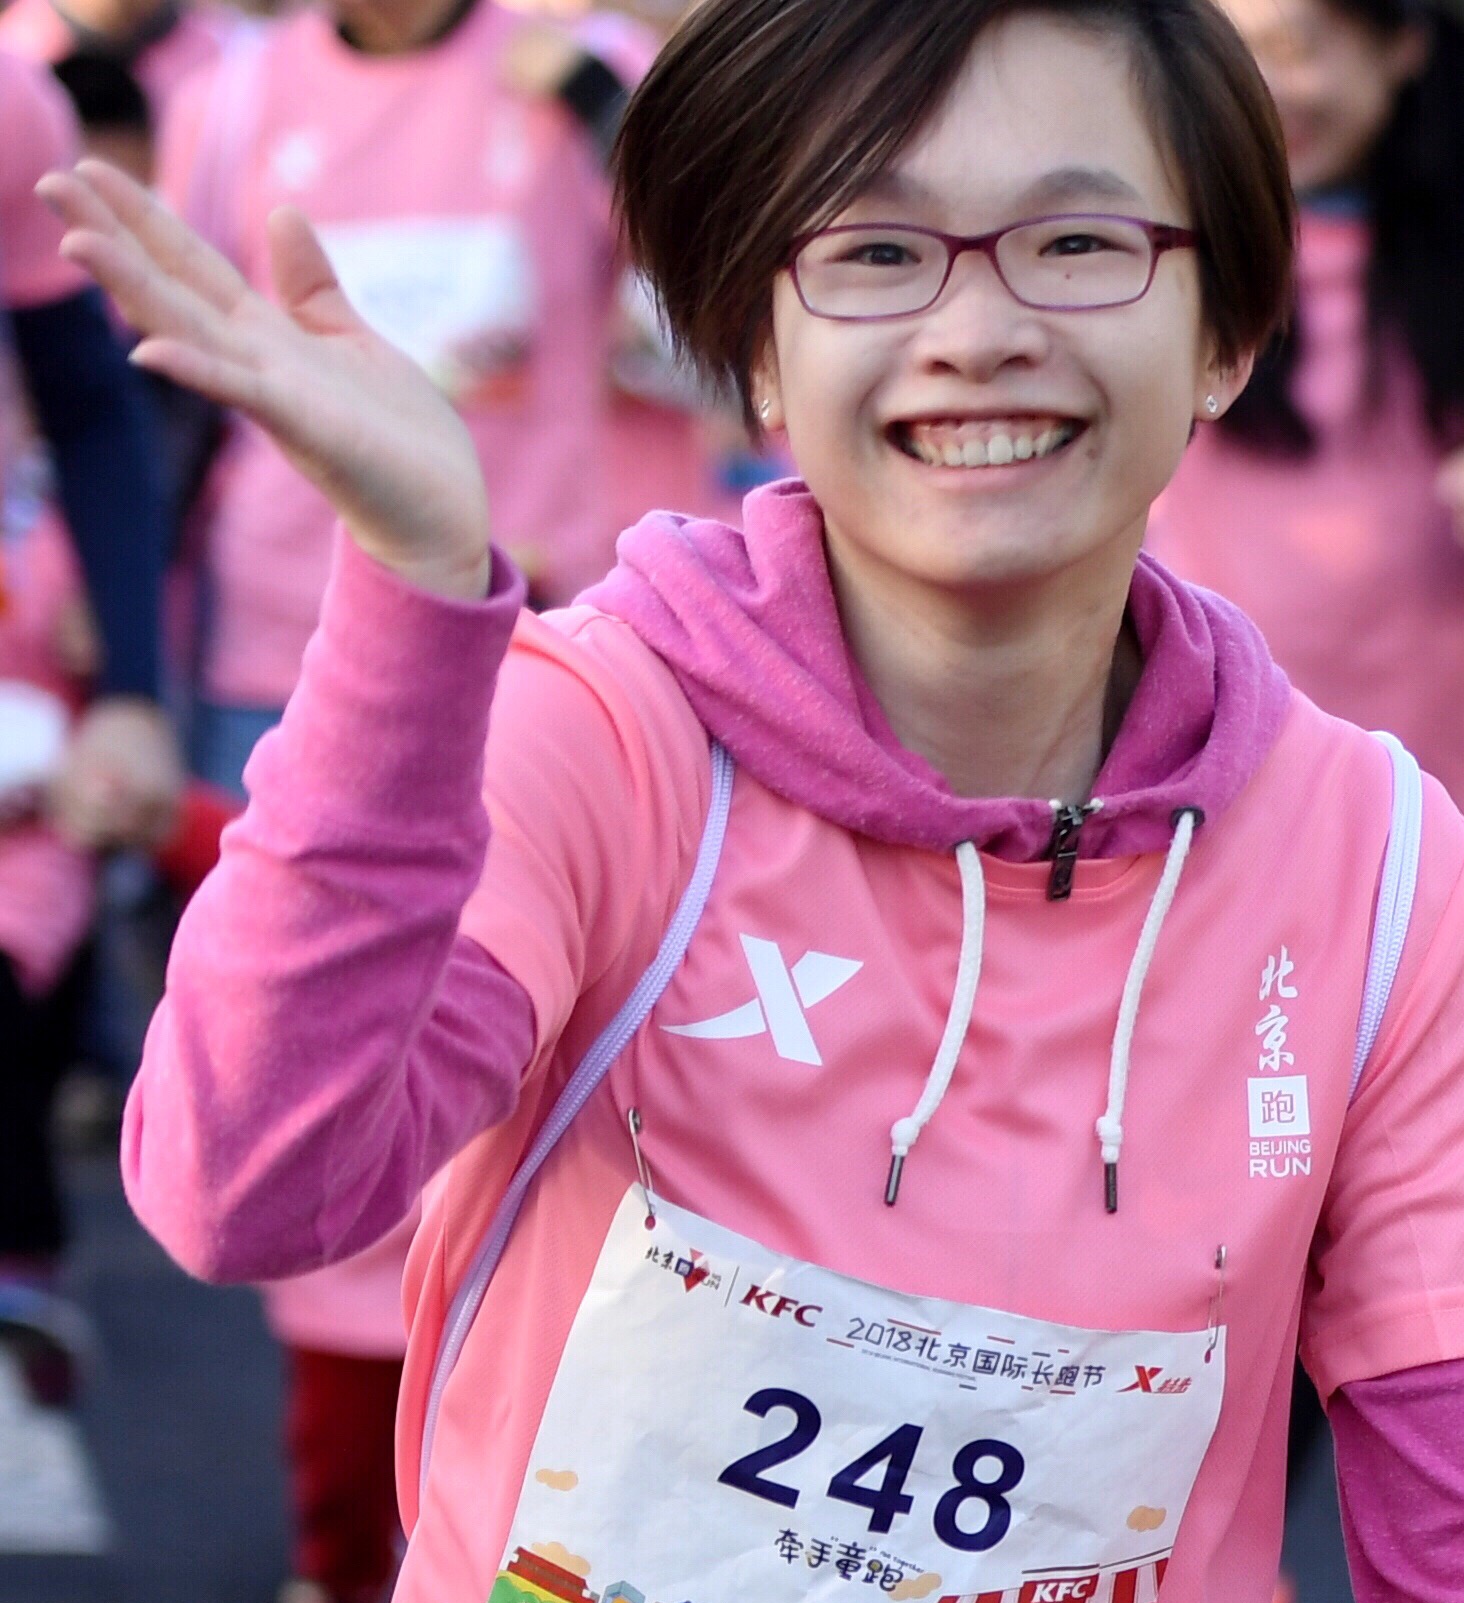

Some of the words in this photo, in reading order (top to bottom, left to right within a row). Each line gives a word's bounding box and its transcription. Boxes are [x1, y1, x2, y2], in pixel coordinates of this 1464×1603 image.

[1248, 1139, 1312, 1157] BEIJING
[1248, 1157, 1312, 1179] RUN
[739, 1284, 824, 1328] KFC
[717, 1387, 1025, 1552] 248
[1030, 1576, 1093, 1603] KFC
